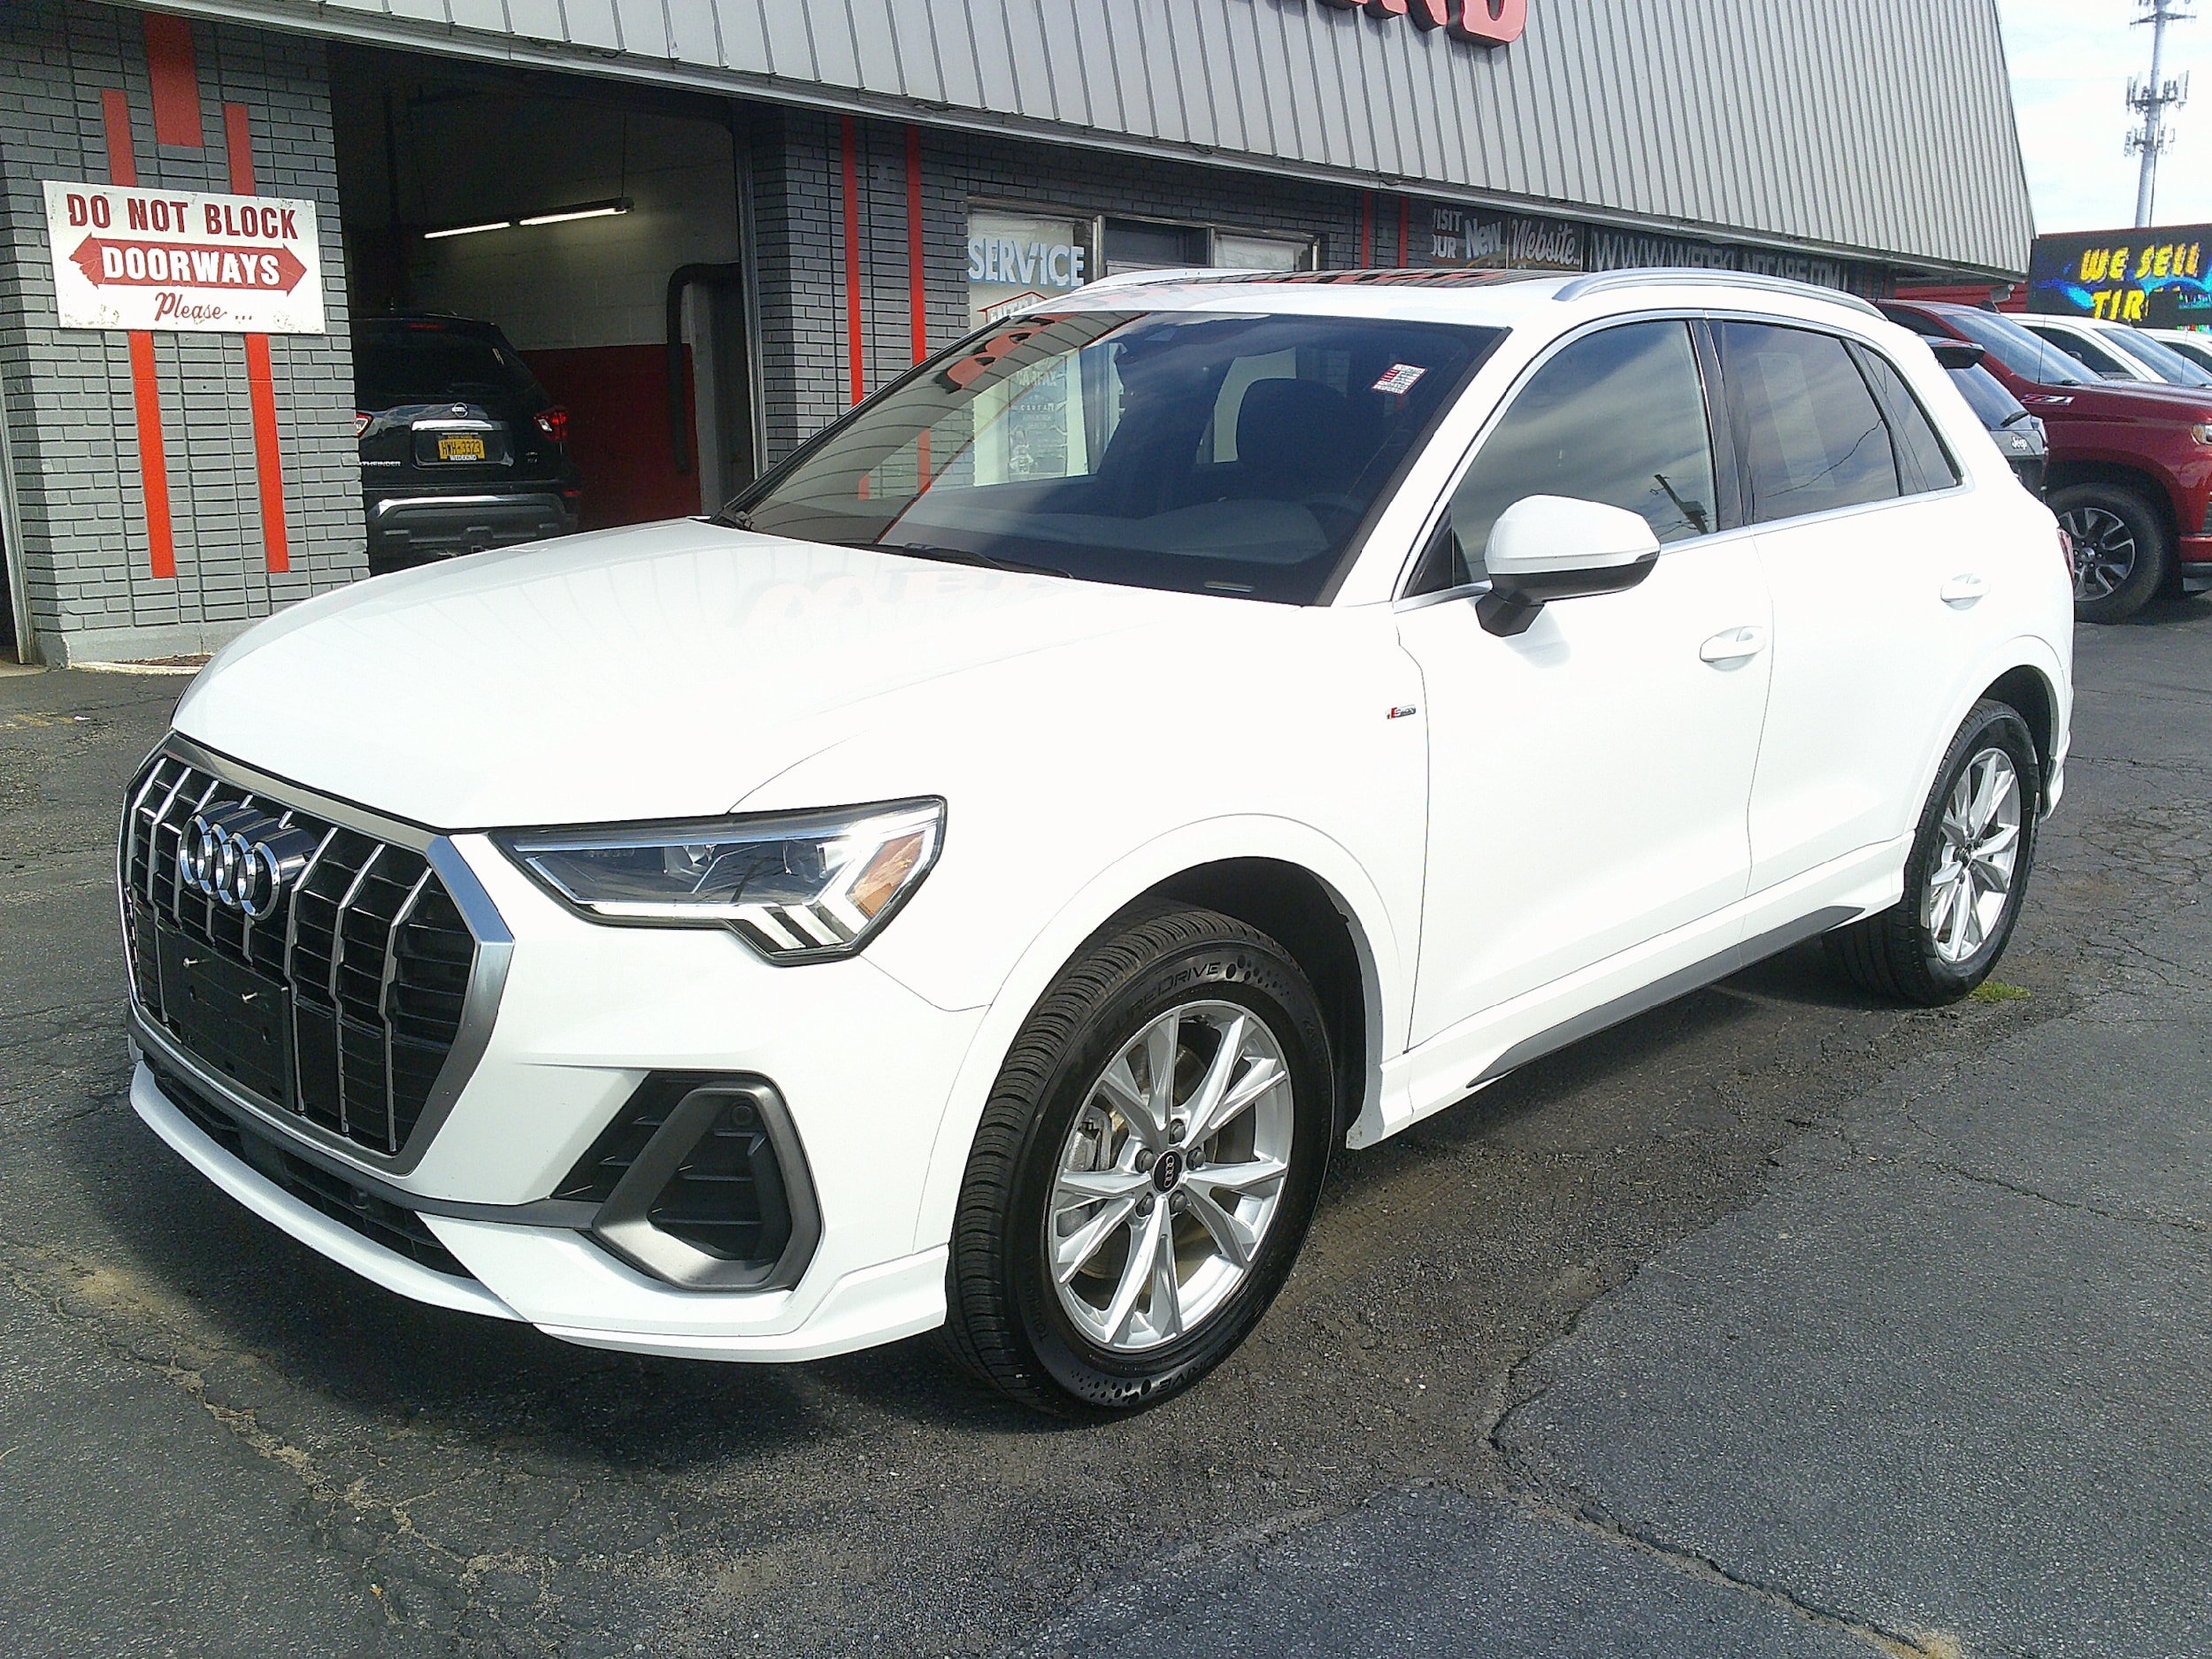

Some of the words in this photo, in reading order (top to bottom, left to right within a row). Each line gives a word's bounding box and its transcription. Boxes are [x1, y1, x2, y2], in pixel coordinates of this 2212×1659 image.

[66, 194, 111, 228] DO
[127, 198, 188, 232] NOT
[204, 204, 298, 240] BLOCK
[1464, 218, 1502, 259] New
[102, 246, 280, 286] DOORWAYS
[968, 238, 1085, 287] SERVICE
[2080, 248, 2130, 283] WE
[2011, 436, 2027, 450] Jeep
